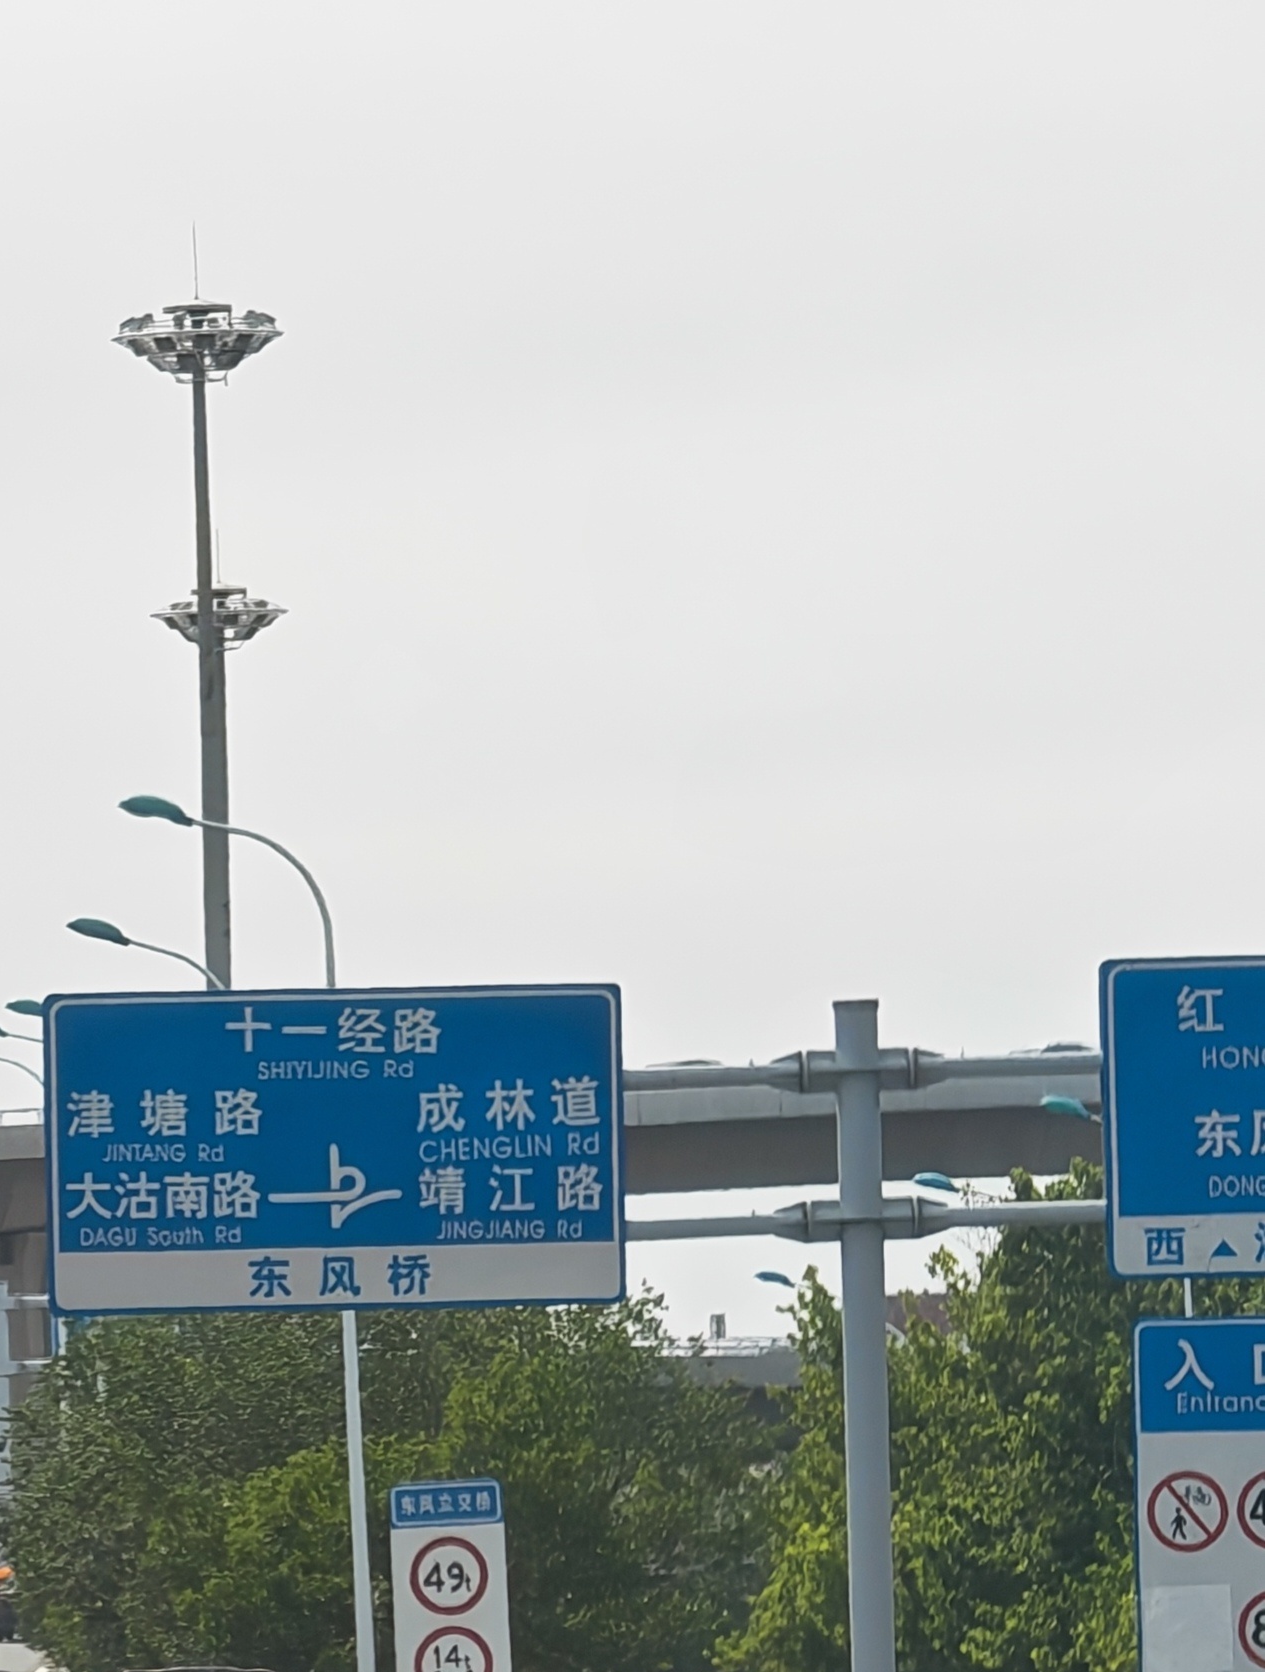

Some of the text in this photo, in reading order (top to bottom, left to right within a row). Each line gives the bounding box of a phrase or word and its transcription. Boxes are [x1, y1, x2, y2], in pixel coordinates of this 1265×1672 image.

[225, 1006, 442, 1055] 十一经路
[1177, 985, 1224, 1033] 红
[257, 1059, 415, 1081] SHIYIJING Rd
[1202, 1045, 1265, 1070] HON
[66, 1088, 263, 1139] 津塘路
[417, 1076, 602, 1134] 成林道
[102, 1143, 224, 1163] JINTANG Rd
[418, 1132, 600, 1164] CHENGLIN Rd
[65, 1171, 261, 1221] 大沽南路
[418, 1164, 603, 1215] 靖江路
[80, 1224, 241, 1247] DAGU South Rd
[437, 1219, 583, 1241] JINGJIANG Rd
[248, 1254, 432, 1299] 东风桥
[1165, 1339, 1265, 1391] 入
